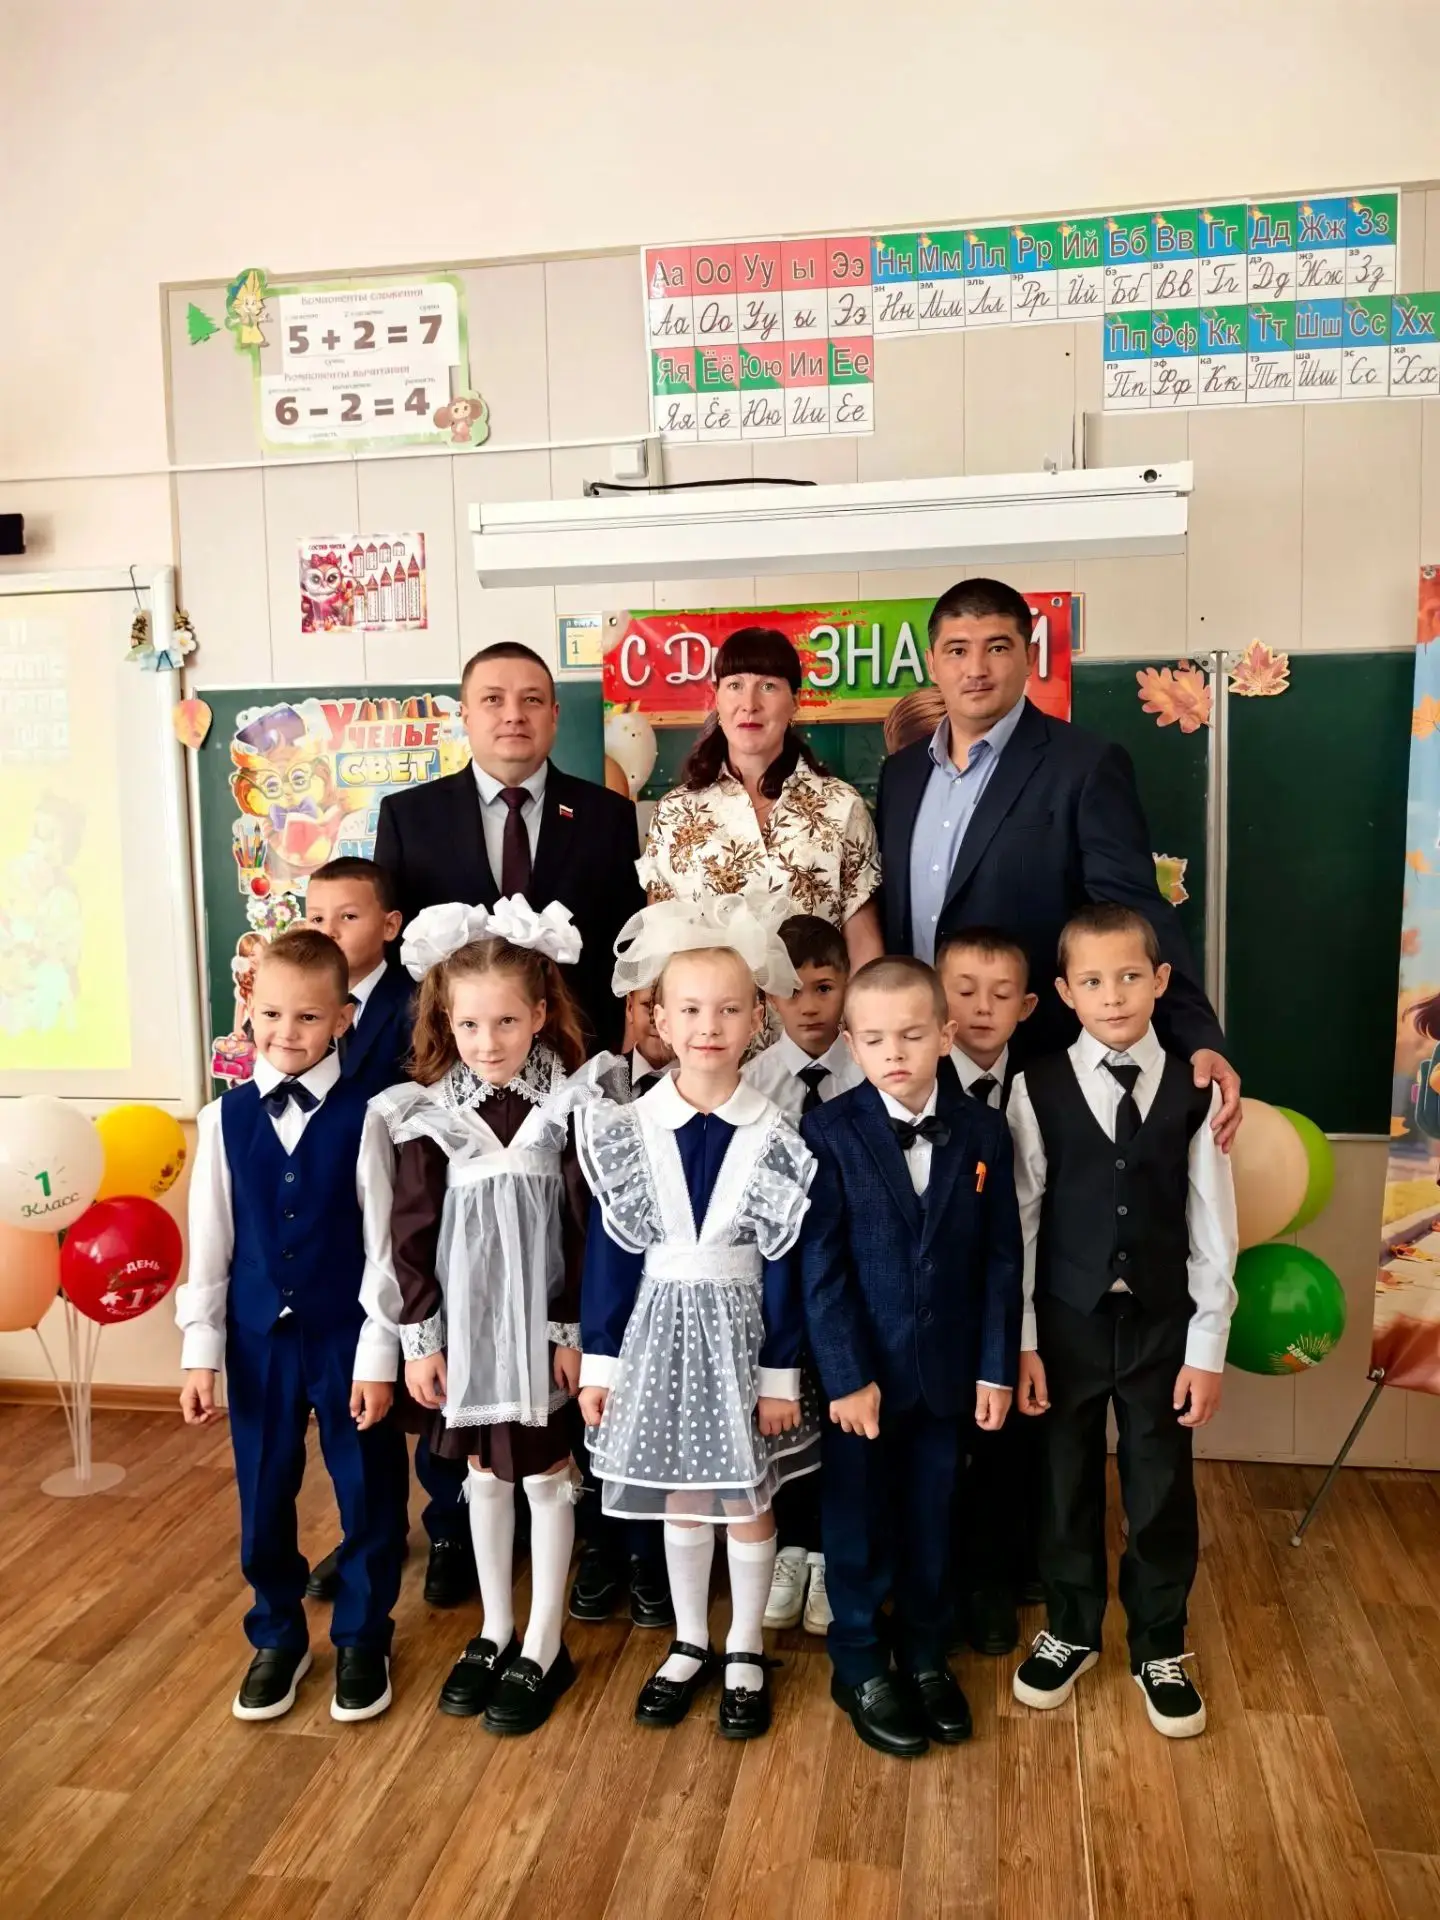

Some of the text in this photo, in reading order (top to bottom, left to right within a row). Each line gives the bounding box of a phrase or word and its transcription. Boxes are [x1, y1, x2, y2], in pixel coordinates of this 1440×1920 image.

[877, 225, 1099, 276] Нн Мм Лл Рр Йй
[1110, 208, 1389, 258] Бб Вв Гг Дд Жж Зз
[653, 251, 865, 288] Аа Оо Уу ы Ээ
[289, 314, 442, 354] 5 + 2 = 7
[1110, 306, 1434, 352] Пп Фф Кк Тт Шш Сс Хх
[659, 348, 869, 384] Яя Ёё Юю Ии Ее
[275, 396, 299, 426] 6
[341, 393, 363, 422] 2
[374, 398, 394, 416] =
[404, 387, 430, 416] 4
[572, 640, 580, 655] 1
[620, 634, 650, 687] С
[808, 608, 1047, 686] ЗНАЙ
[35, 1171, 51, 1197] 1
[21, 1192, 80, 1217] Класс
[126, 1260, 160, 1274] ДЕНЬ
[126, 1288, 144, 1309] 1
